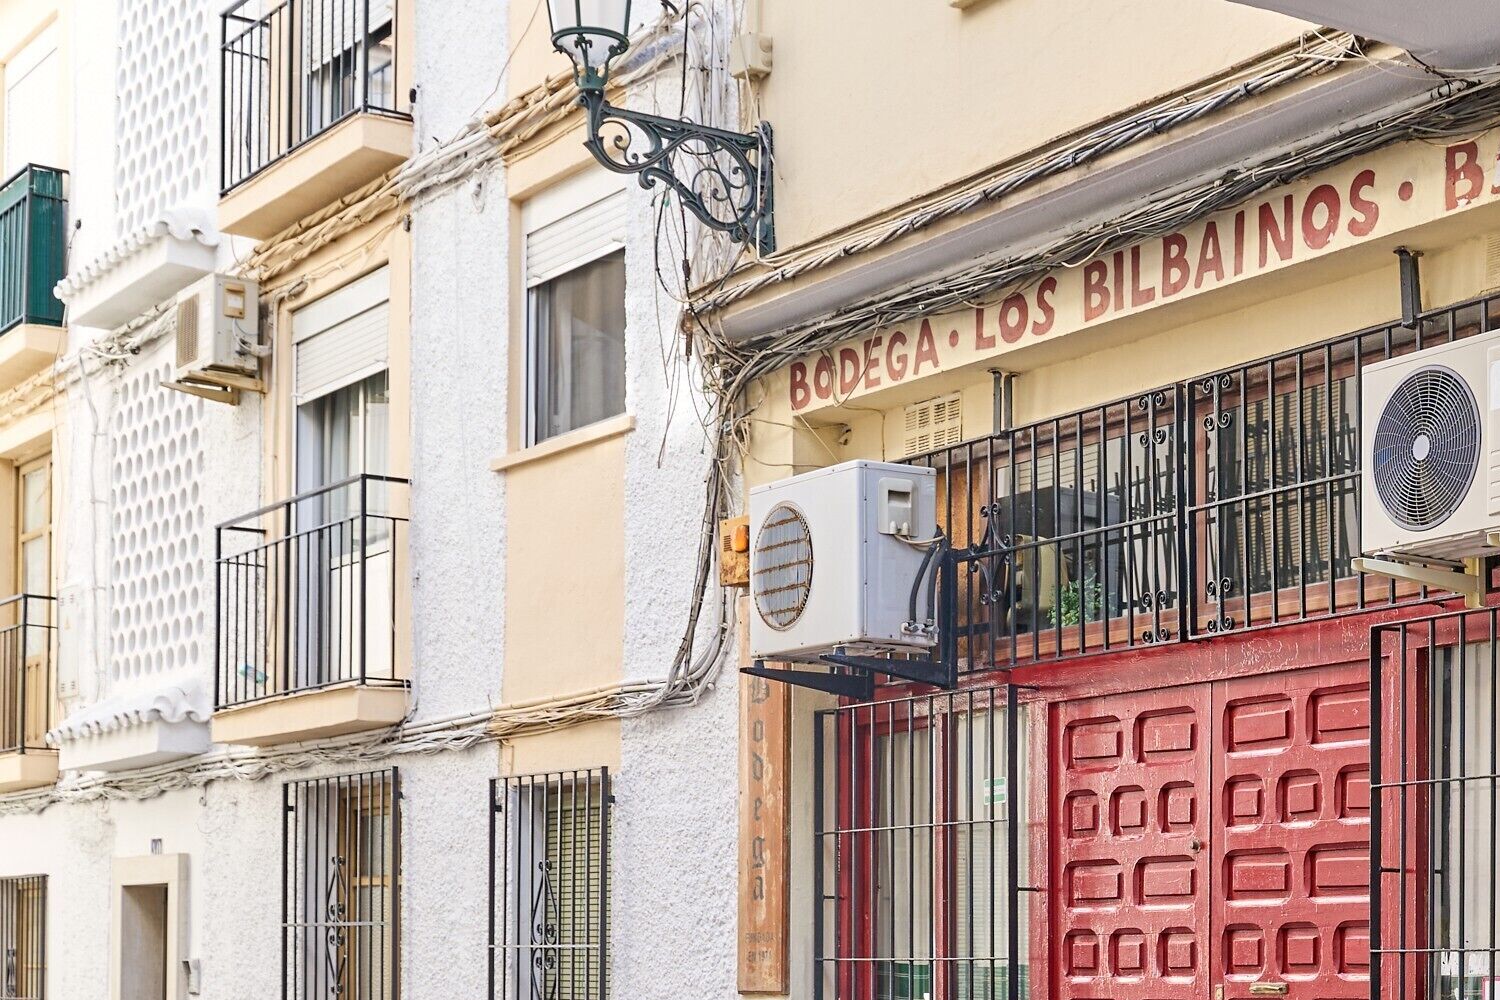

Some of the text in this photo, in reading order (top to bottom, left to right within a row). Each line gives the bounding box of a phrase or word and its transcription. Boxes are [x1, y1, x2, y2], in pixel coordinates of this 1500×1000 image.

[789, 317, 939, 411] BODEGA
[975, 276, 1058, 351] LOS
[1083, 168, 1380, 323] BILBAINOS
